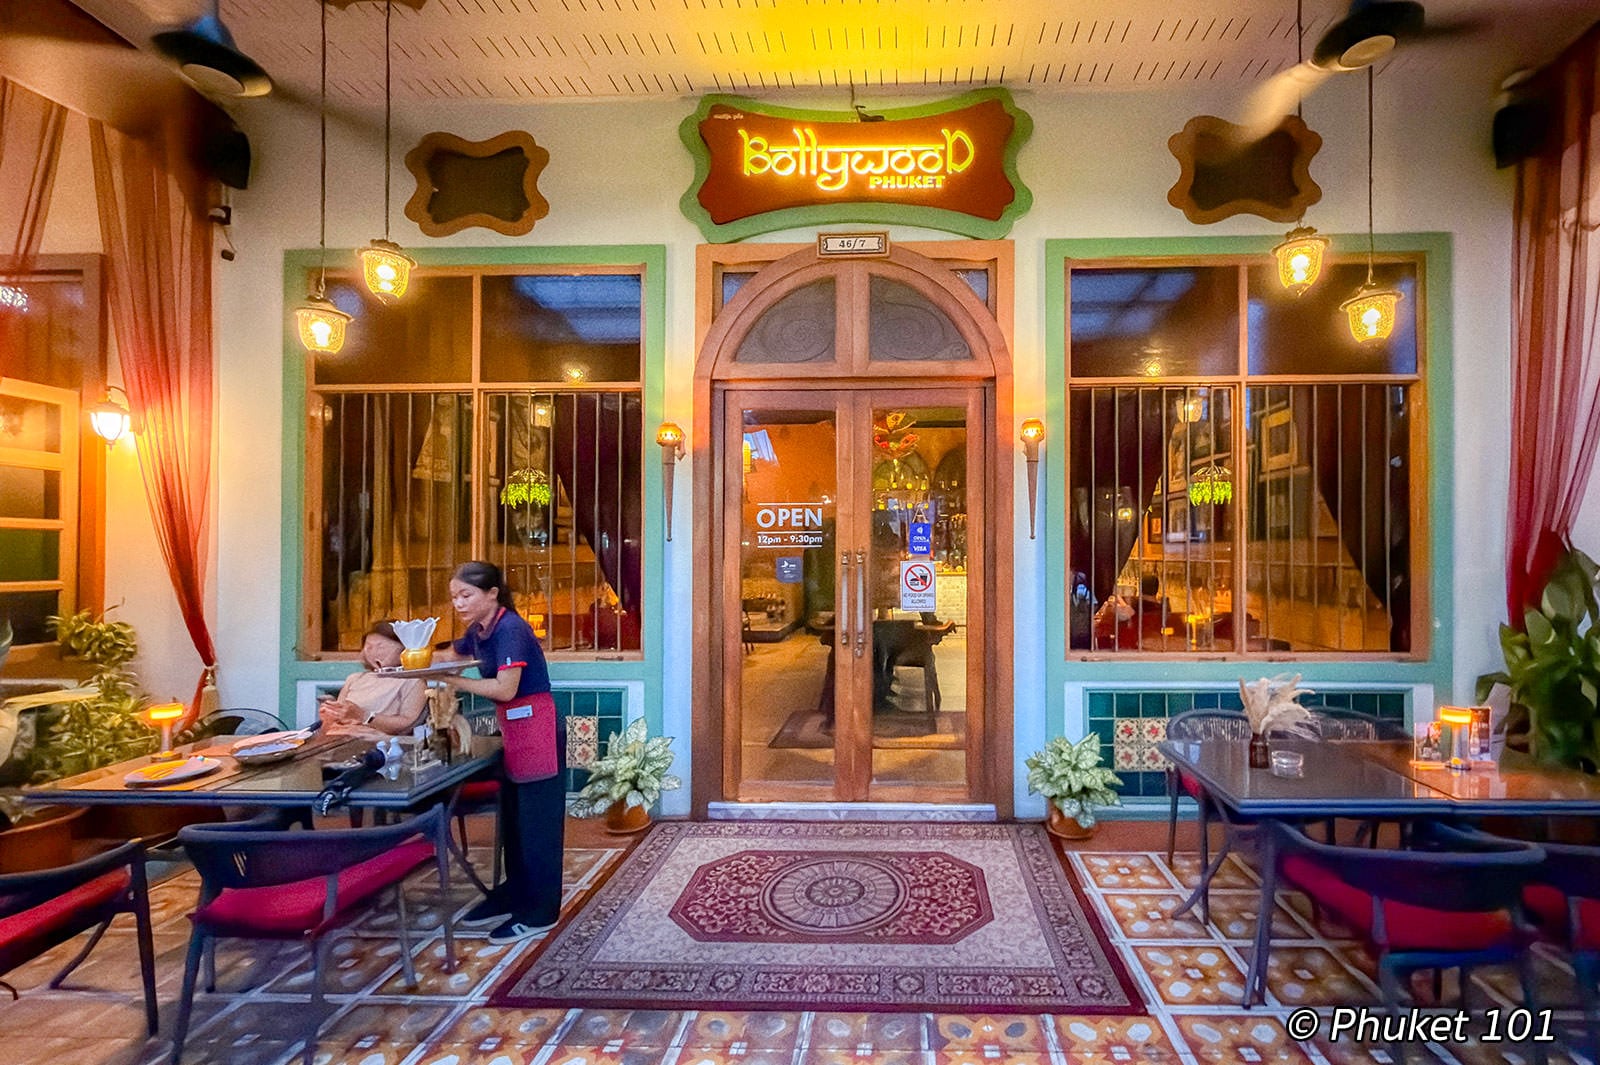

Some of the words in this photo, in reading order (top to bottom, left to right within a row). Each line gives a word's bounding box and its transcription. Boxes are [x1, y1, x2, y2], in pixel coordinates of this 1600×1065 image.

[869, 175, 945, 189] PHUKET
[839, 238, 866, 250] 46/7
[756, 508, 823, 528] OPEN
[757, 535, 781, 545] 12pm
[790, 535, 823, 545] 9:30pm
